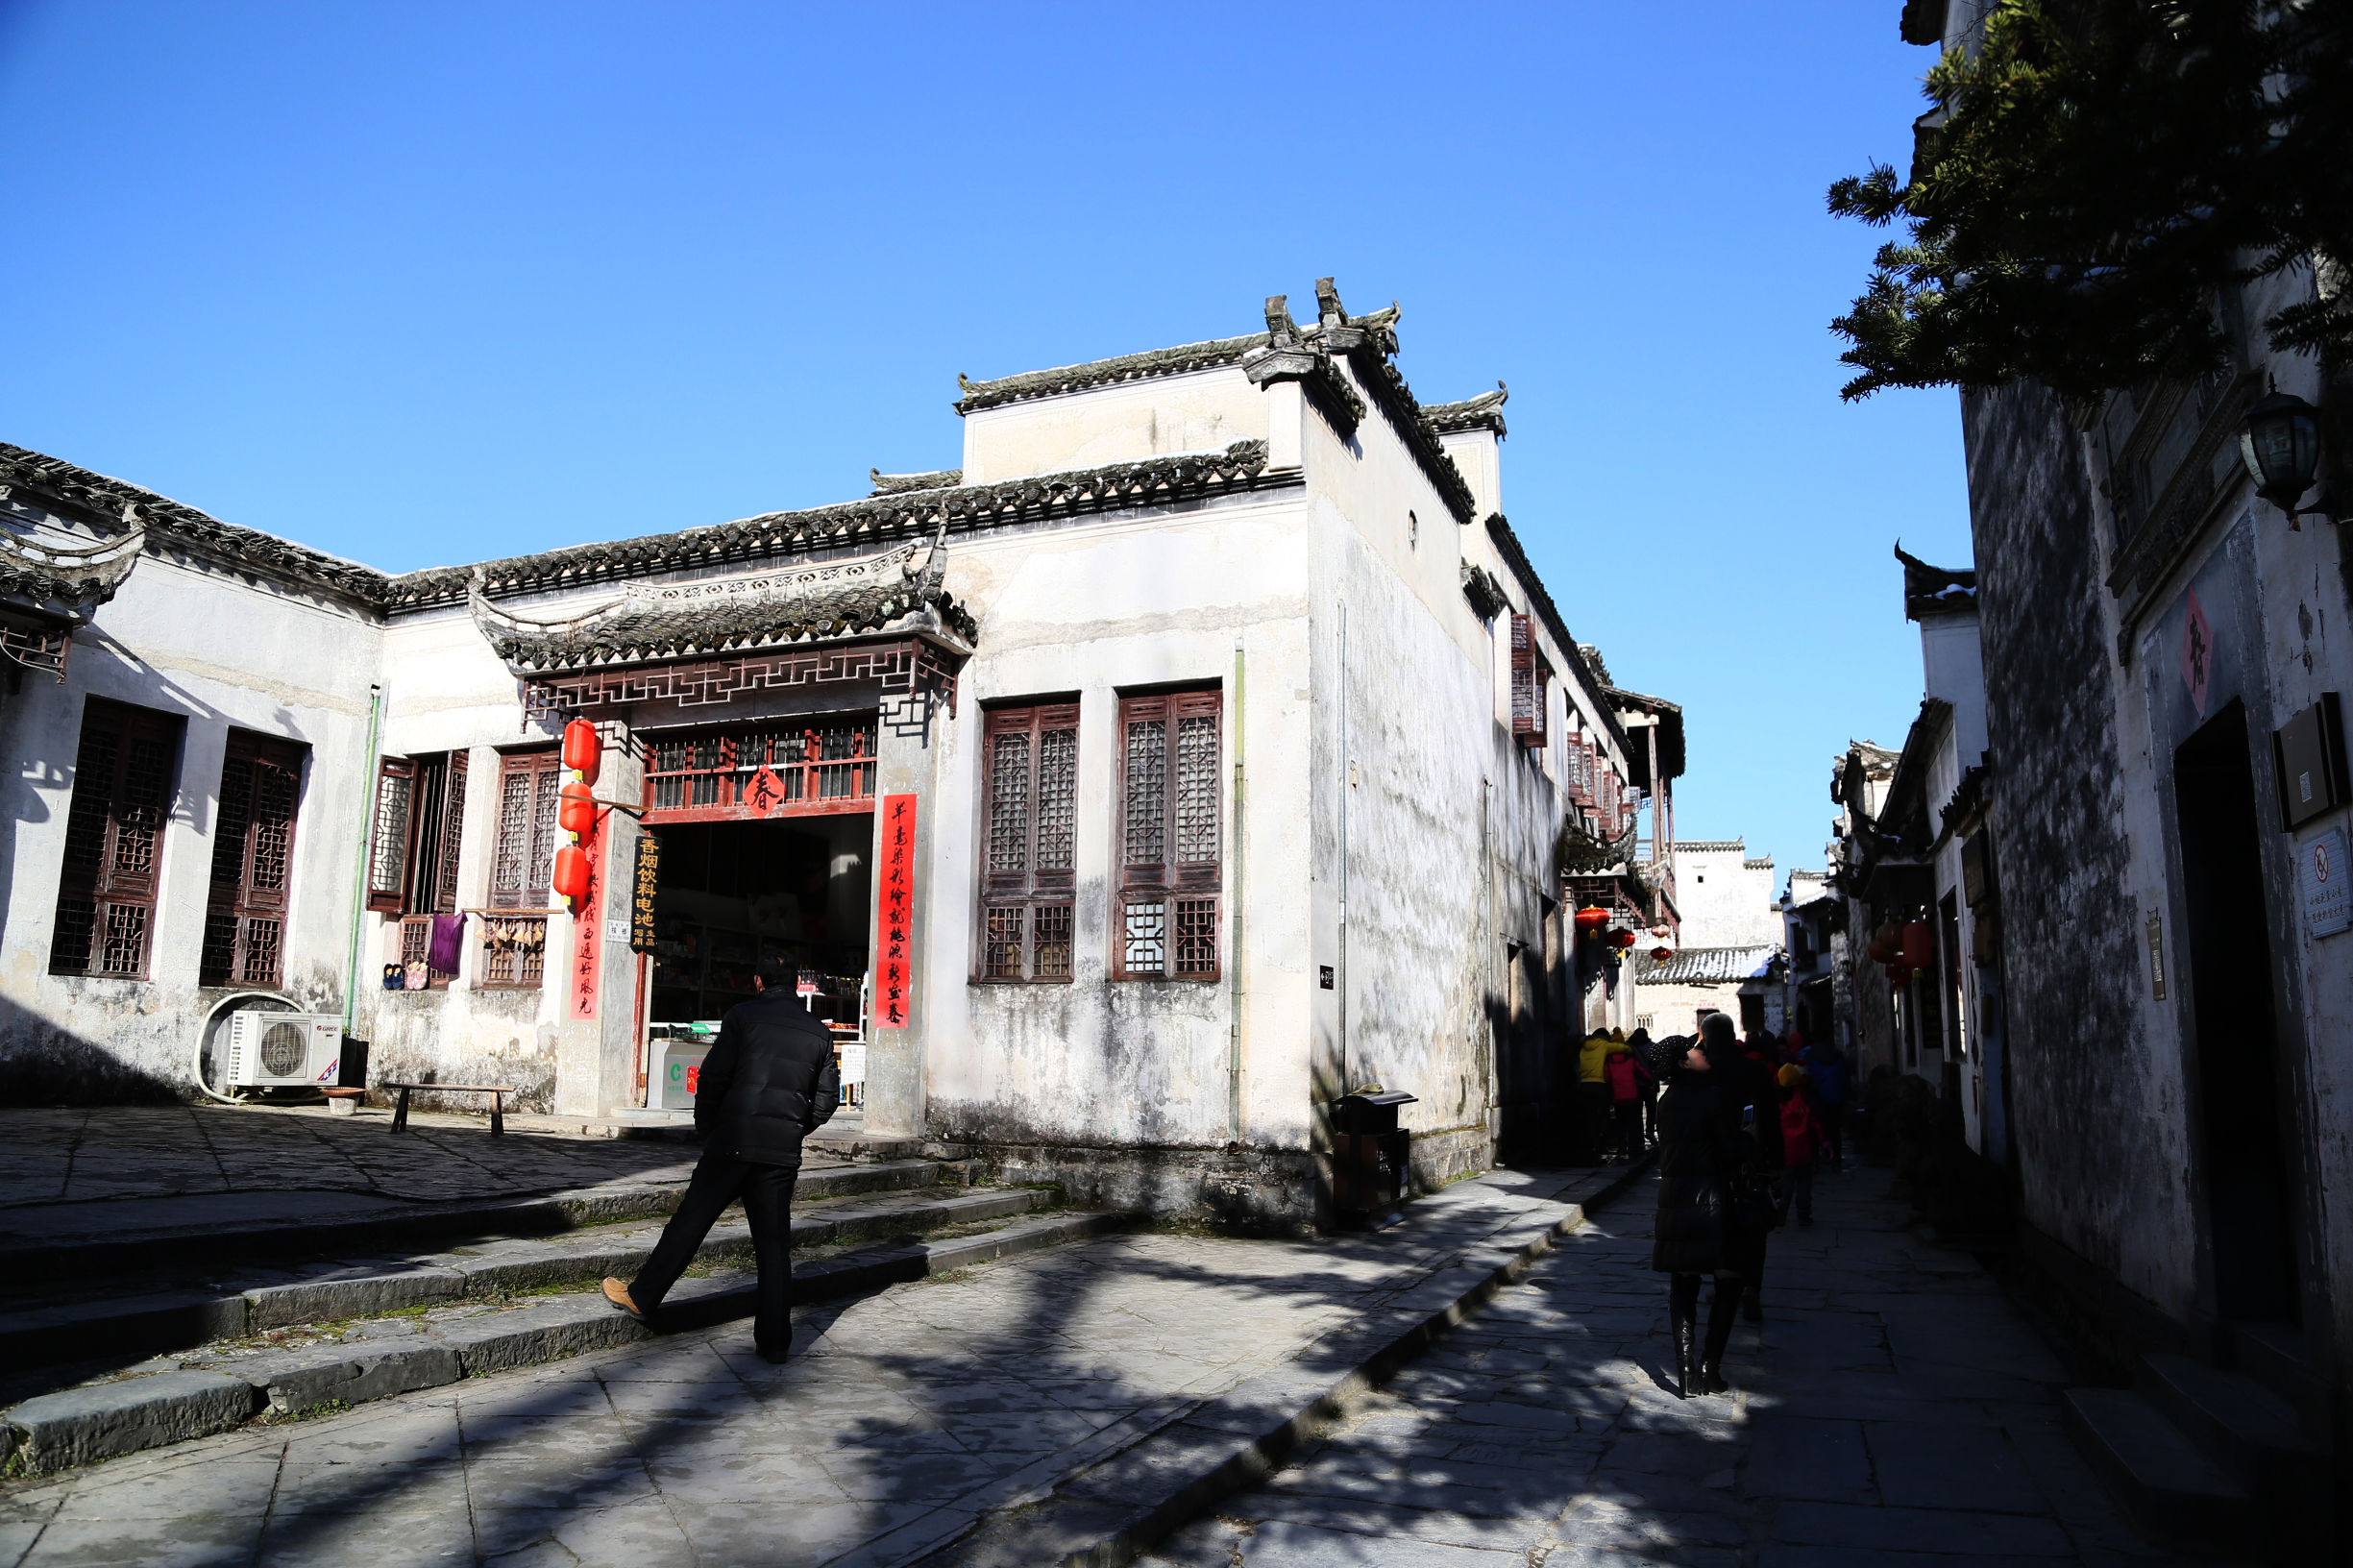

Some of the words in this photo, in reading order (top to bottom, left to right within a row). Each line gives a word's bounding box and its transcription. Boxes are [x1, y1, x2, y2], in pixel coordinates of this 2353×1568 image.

[751, 772, 779, 810] 春
[634, 838, 660, 928] 香烟饮料电池
